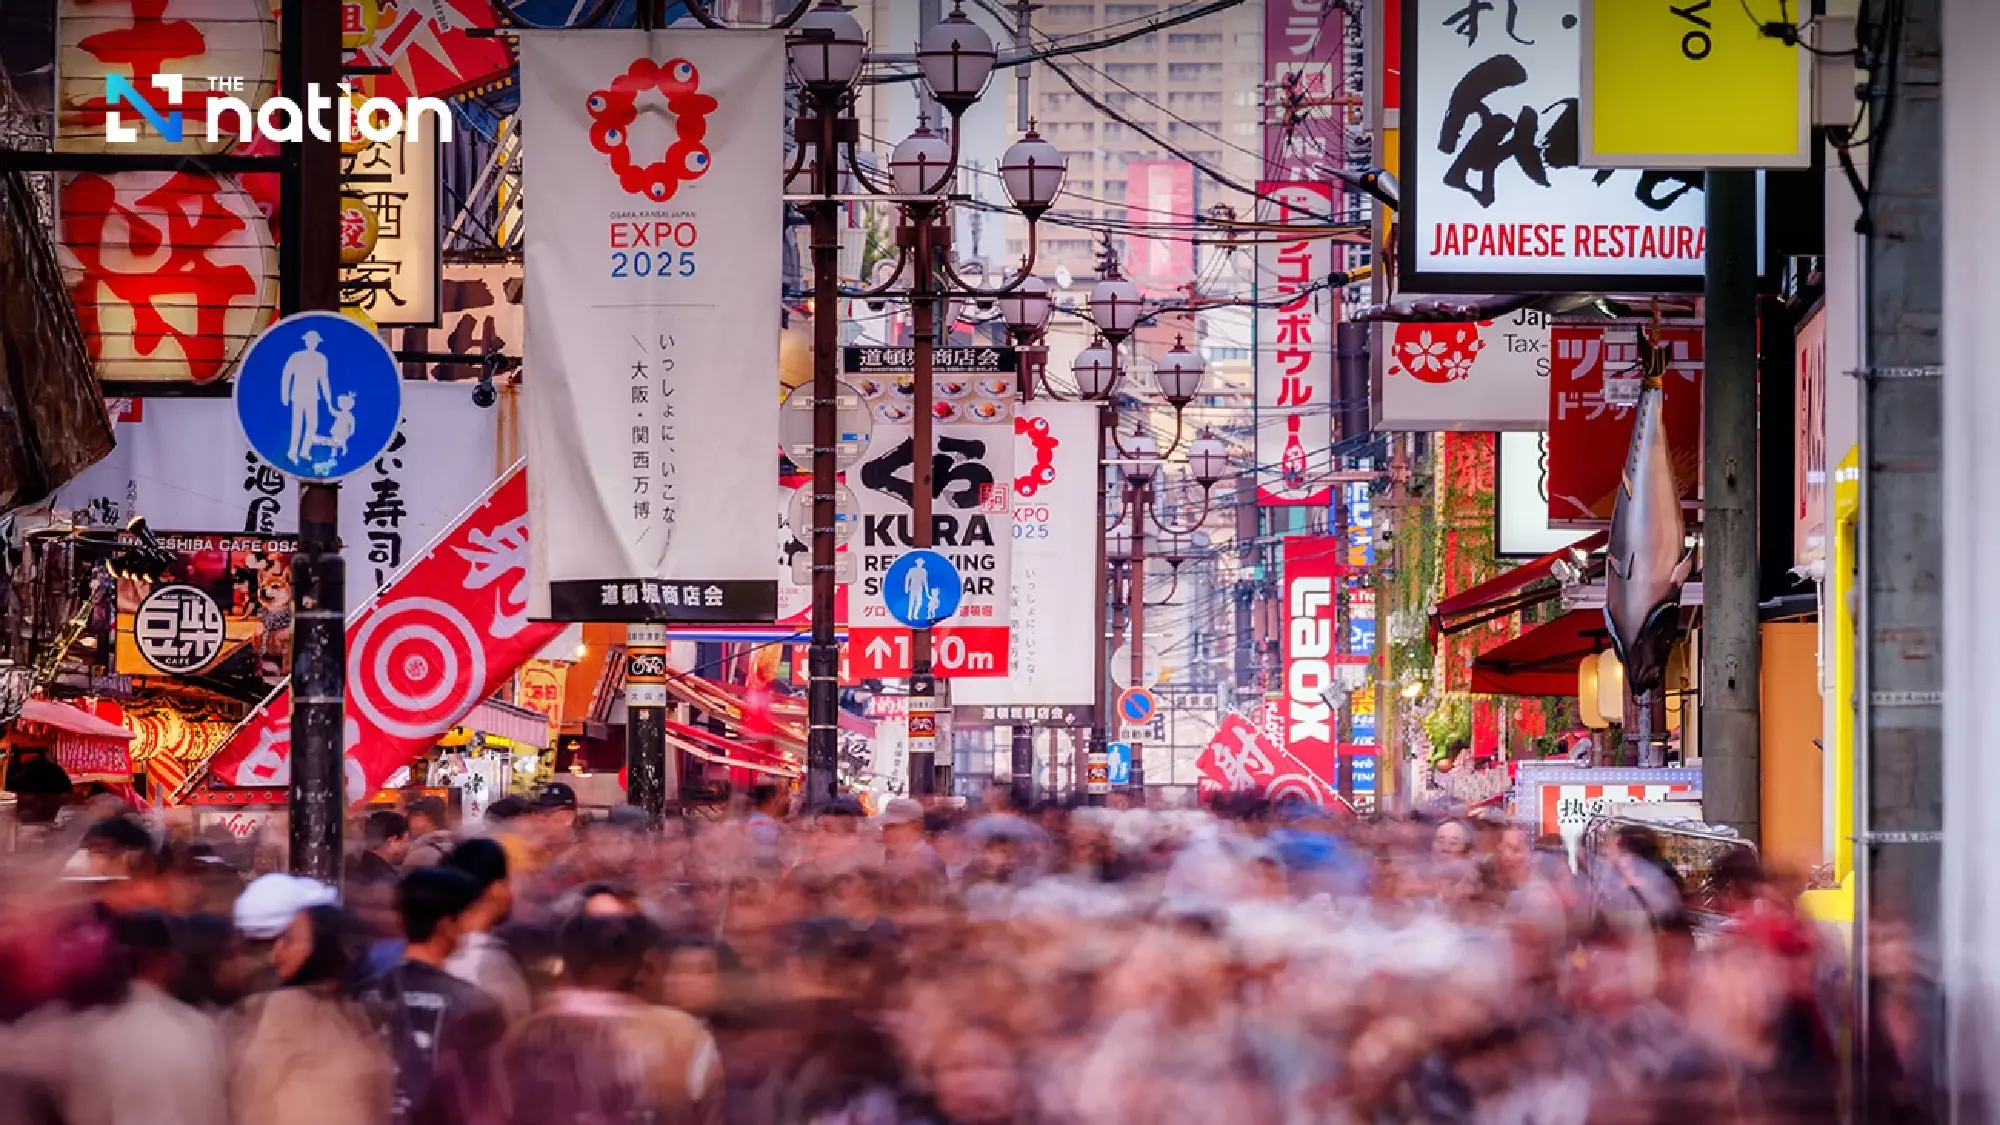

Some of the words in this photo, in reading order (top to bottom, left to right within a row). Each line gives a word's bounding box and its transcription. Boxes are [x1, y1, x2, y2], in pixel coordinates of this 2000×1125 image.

[610, 222, 698, 249] EXPO
[1429, 222, 1567, 257] JAPANESE
[1574, 224, 1707, 259] RESTAURA
[611, 251, 696, 278] 2025
[1503, 334, 1549, 353] Tax-
[1557, 391, 1637, 421] ドラッ
[1012, 507, 1050, 523] XPO
[1012, 524, 1049, 539] 025
[219, 538, 261, 553] CAFE
[267, 540, 298, 553] OSA
[165, 657, 190, 667] CAFE
